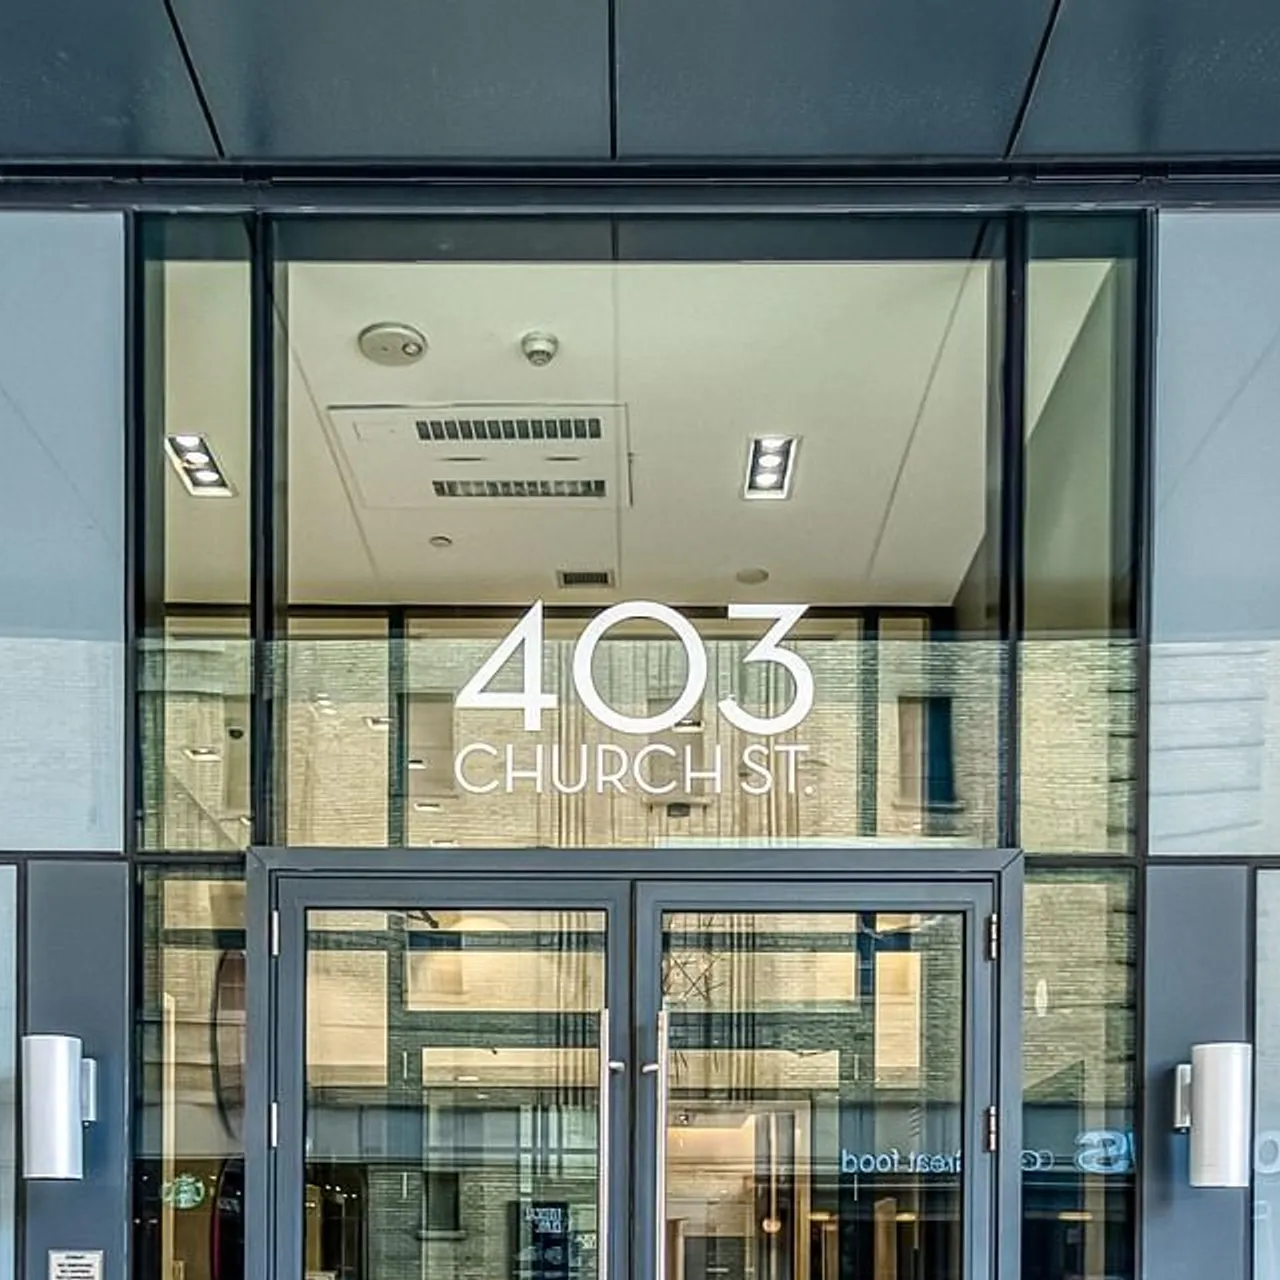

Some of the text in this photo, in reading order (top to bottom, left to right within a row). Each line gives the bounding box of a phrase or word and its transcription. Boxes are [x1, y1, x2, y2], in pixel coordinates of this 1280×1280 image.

[454, 599, 815, 735] 403
[454, 742, 816, 795] CHURCH ST.
